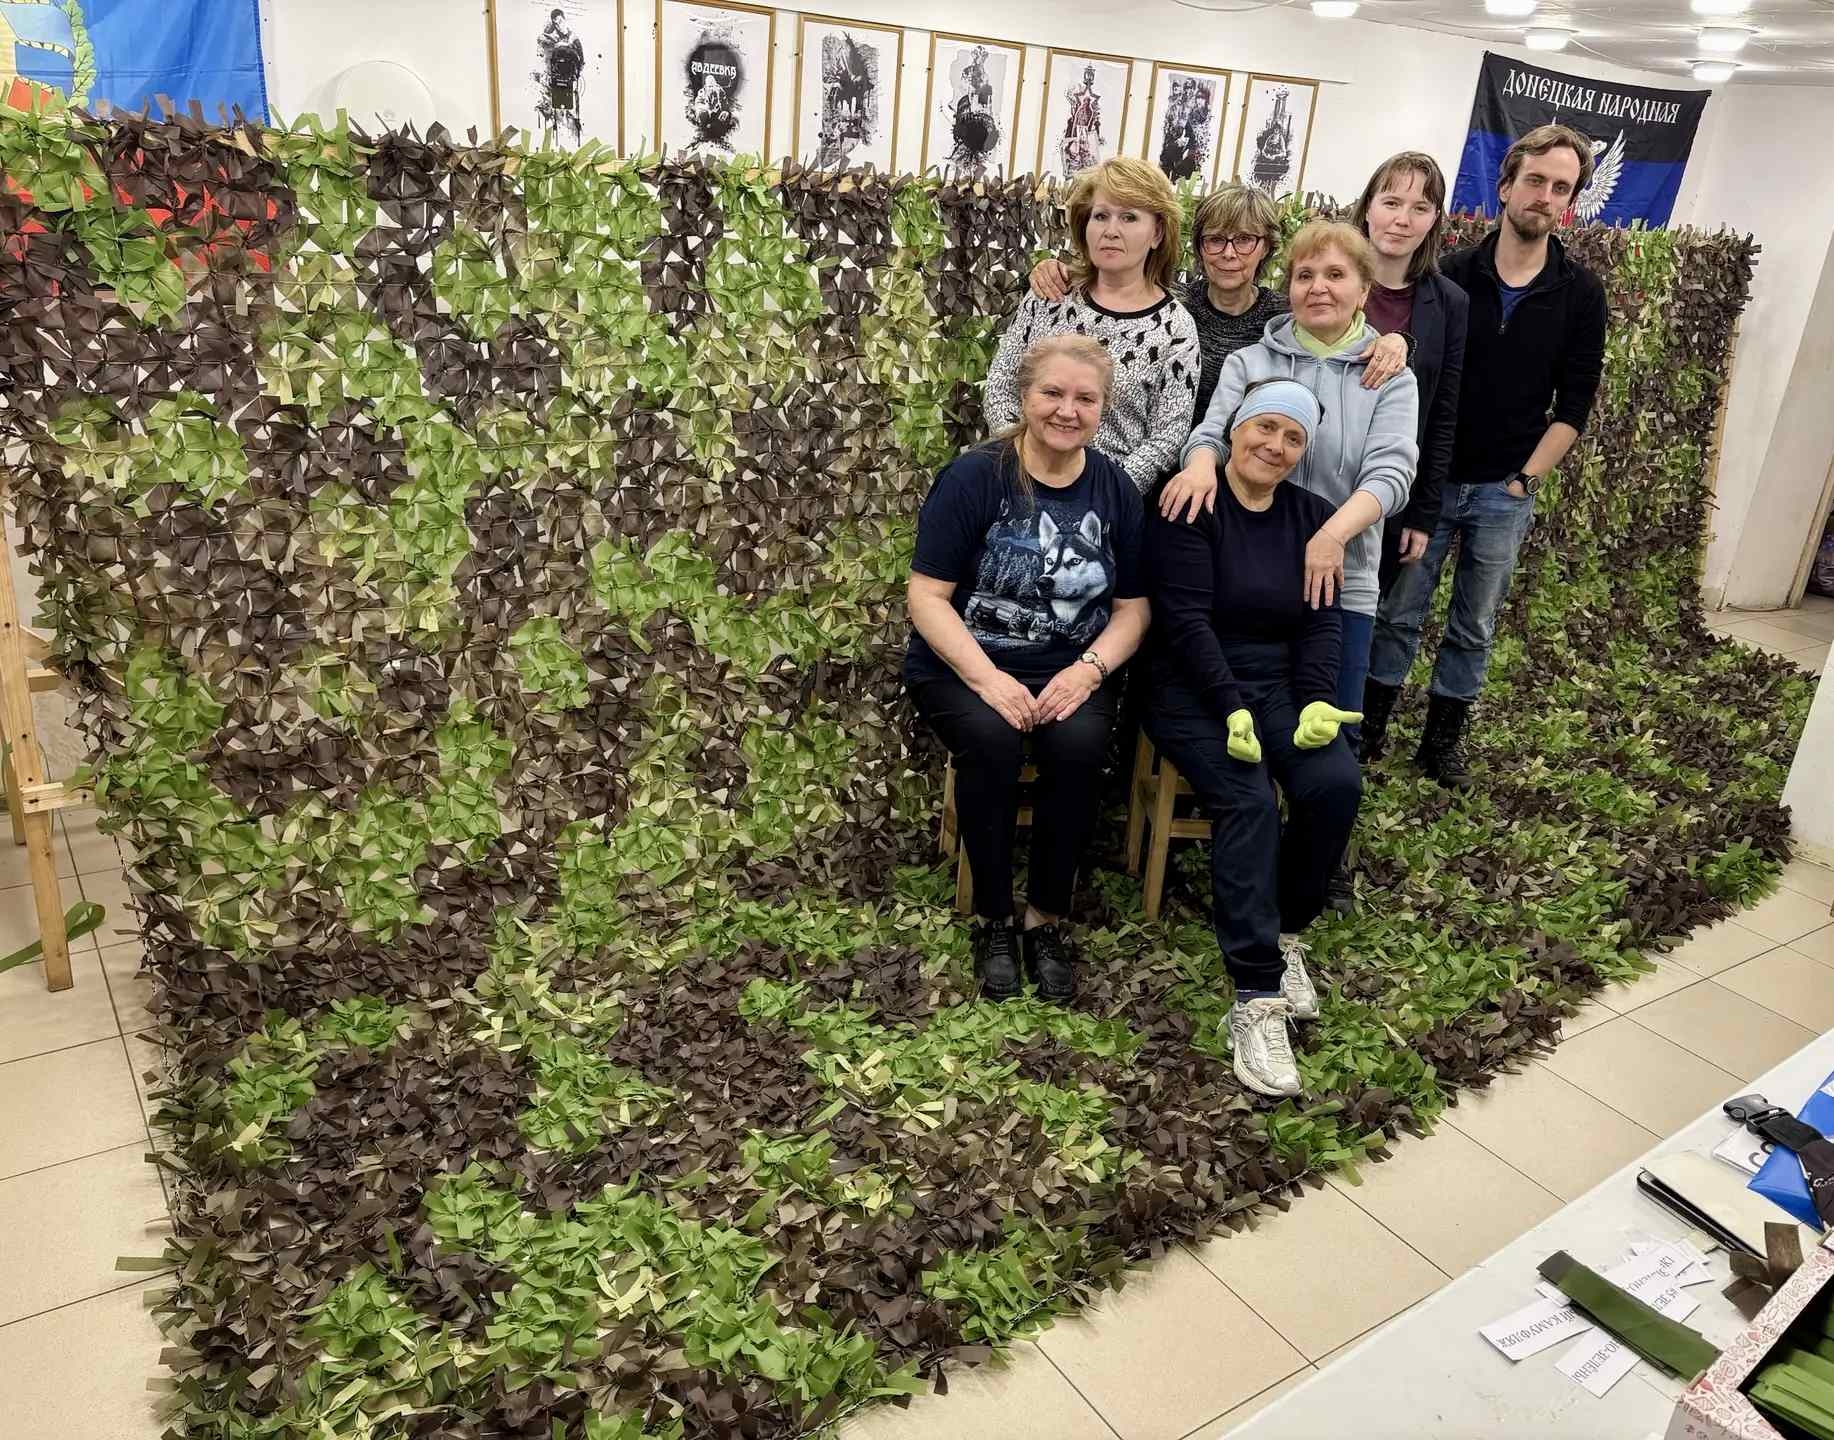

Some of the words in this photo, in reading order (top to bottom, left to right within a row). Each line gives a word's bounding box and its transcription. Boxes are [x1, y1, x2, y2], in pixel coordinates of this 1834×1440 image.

[691, 61, 737, 80] АВДЕЕВКА
[1502, 68, 1597, 111] ДОНЕЦКАЯ
[1598, 92, 1682, 125] НАРОДНАЯ
